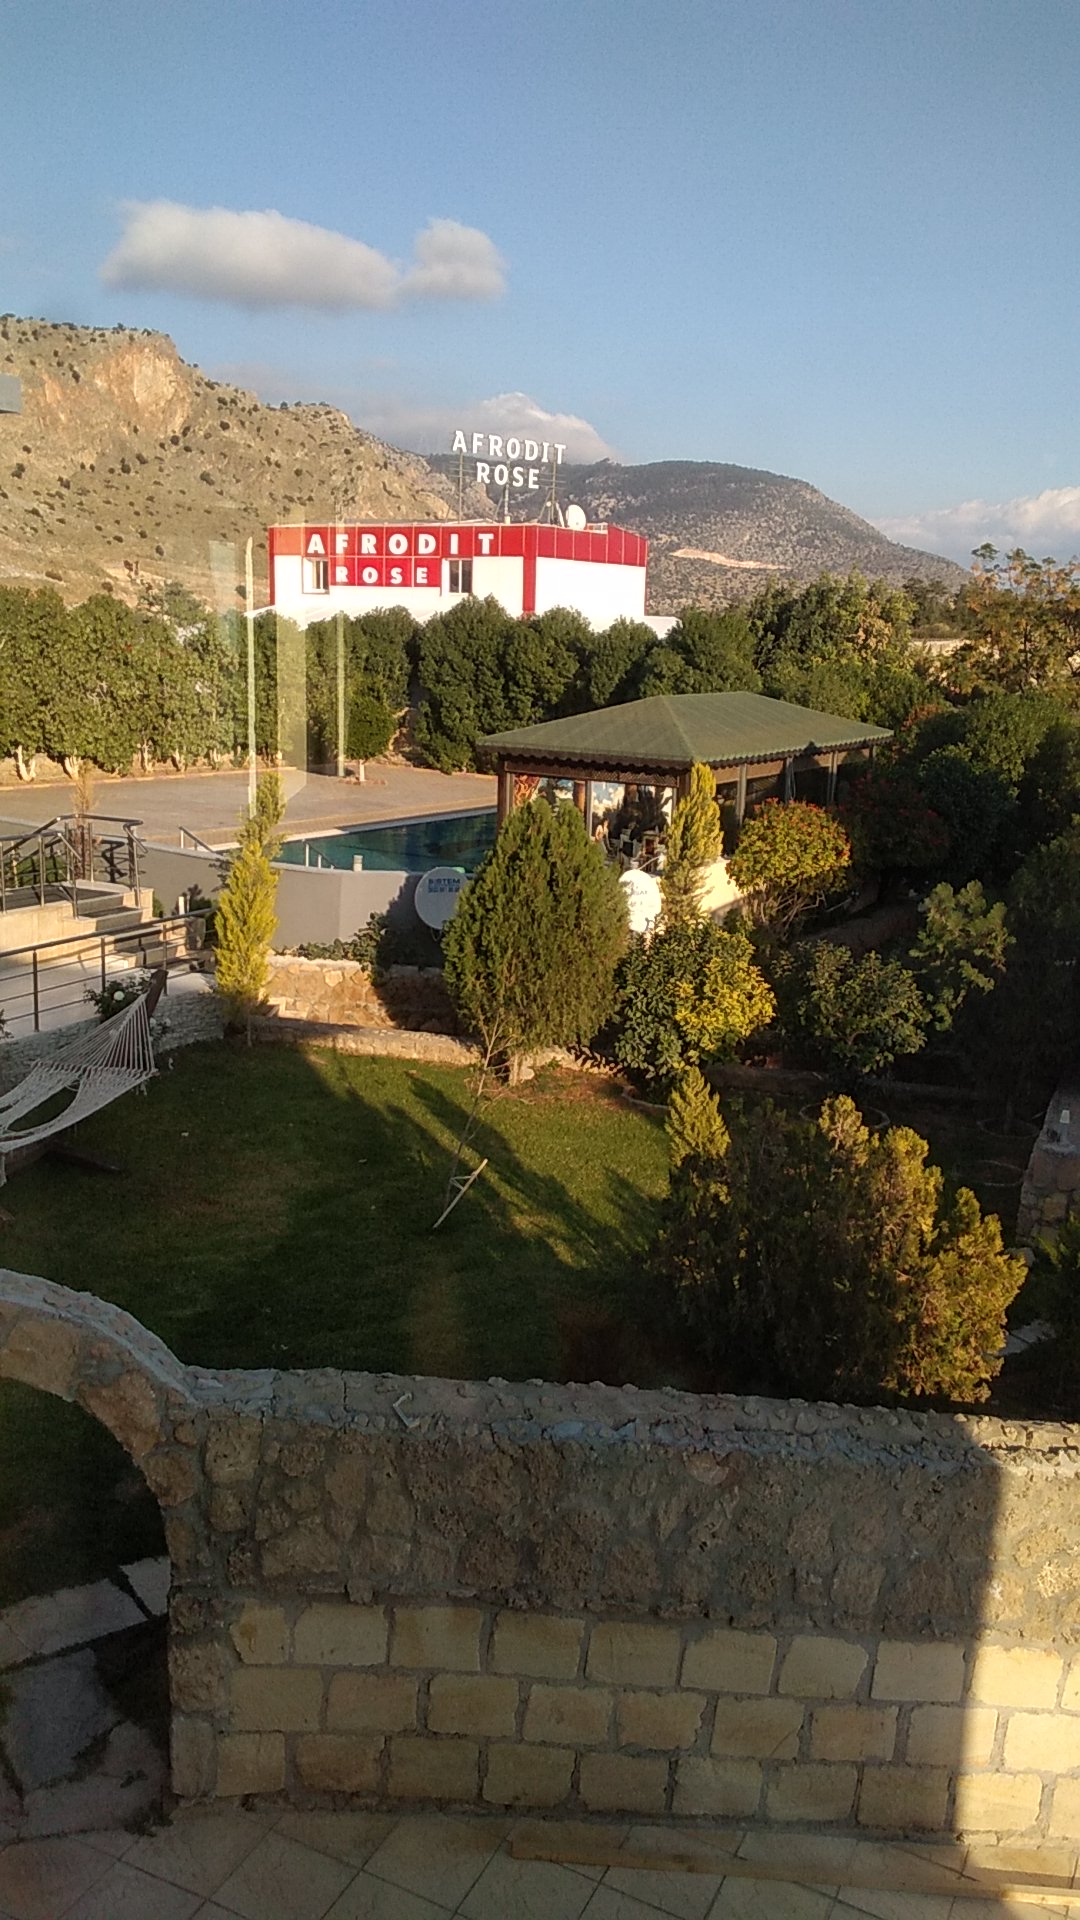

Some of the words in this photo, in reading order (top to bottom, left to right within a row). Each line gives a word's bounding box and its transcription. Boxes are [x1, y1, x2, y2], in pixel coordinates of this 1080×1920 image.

[452, 430, 567, 465] AFRODIT
[476, 461, 540, 489] ROSE
[307, 533, 494, 554] AFRODIT
[335, 566, 428, 583] ROSE
